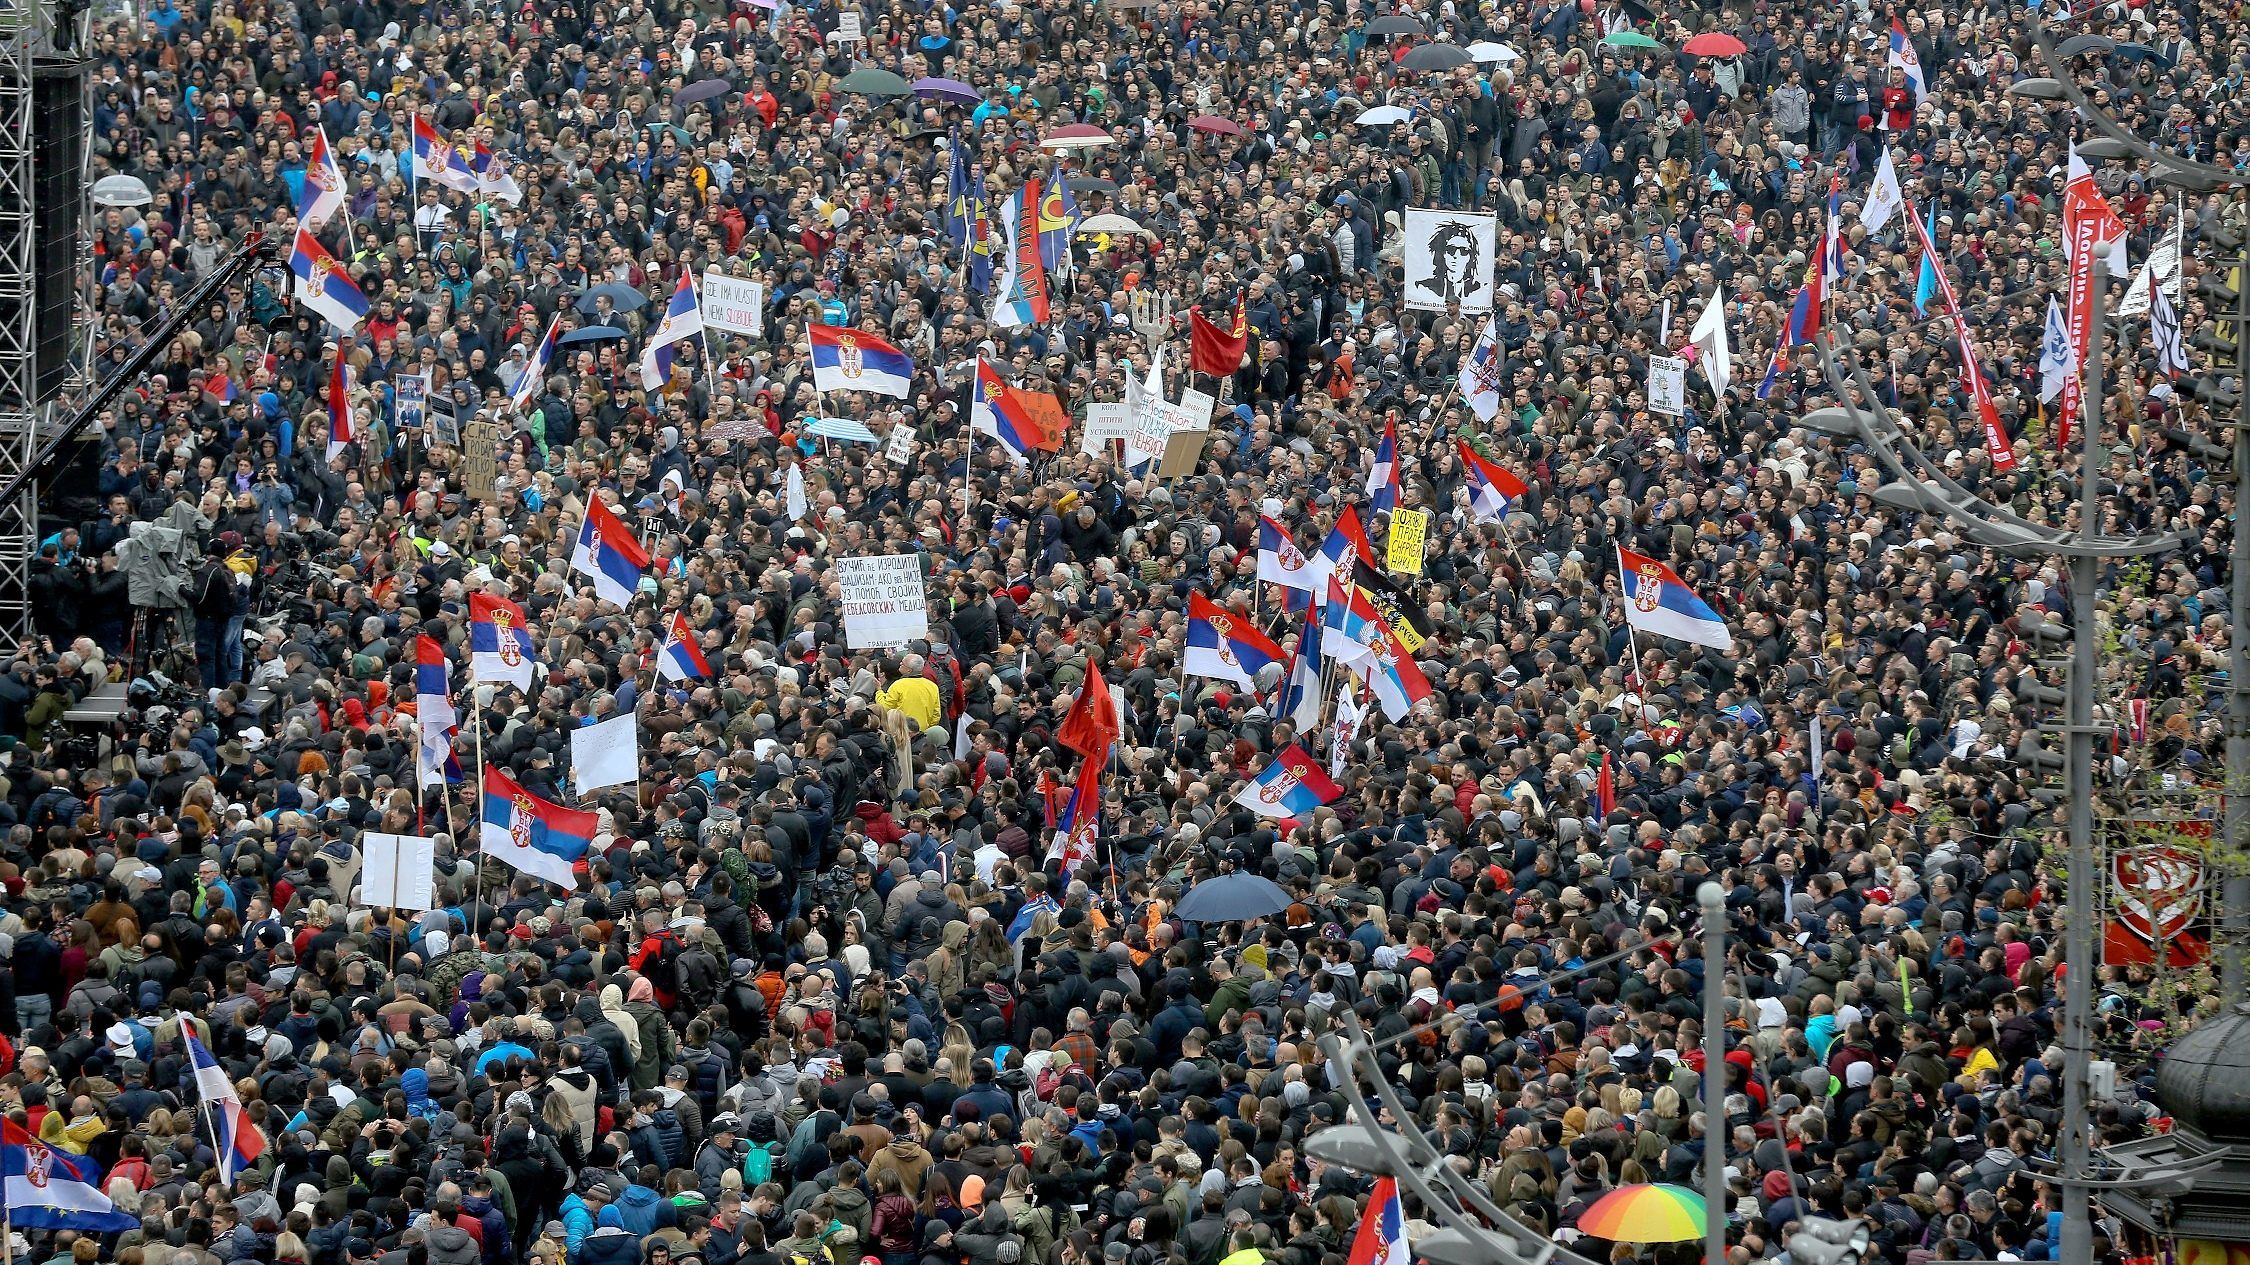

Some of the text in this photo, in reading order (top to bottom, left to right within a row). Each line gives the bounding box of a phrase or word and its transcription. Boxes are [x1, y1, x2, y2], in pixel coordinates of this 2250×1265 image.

[1016, 206, 1040, 301] НИСАМ
[2075, 219, 2095, 306] GRADOVI
[705, 281, 757, 306] GDE IMA VLASTI
[708, 304, 753, 327] NEMA SLOBODE
[1101, 404, 1118, 412] КОГА
[877, 556, 918, 571] ИЗРОДИТИ
[903, 570, 922, 584] НИЈЕ
[842, 585, 920, 601] УЗ ПОМОЋ СВОЈИХ
[843, 598, 926, 616] ГЕБЕЛСОВСКИХ МЕДИЈА
[867, 639, 903, 648] ГРАЂАНИН
